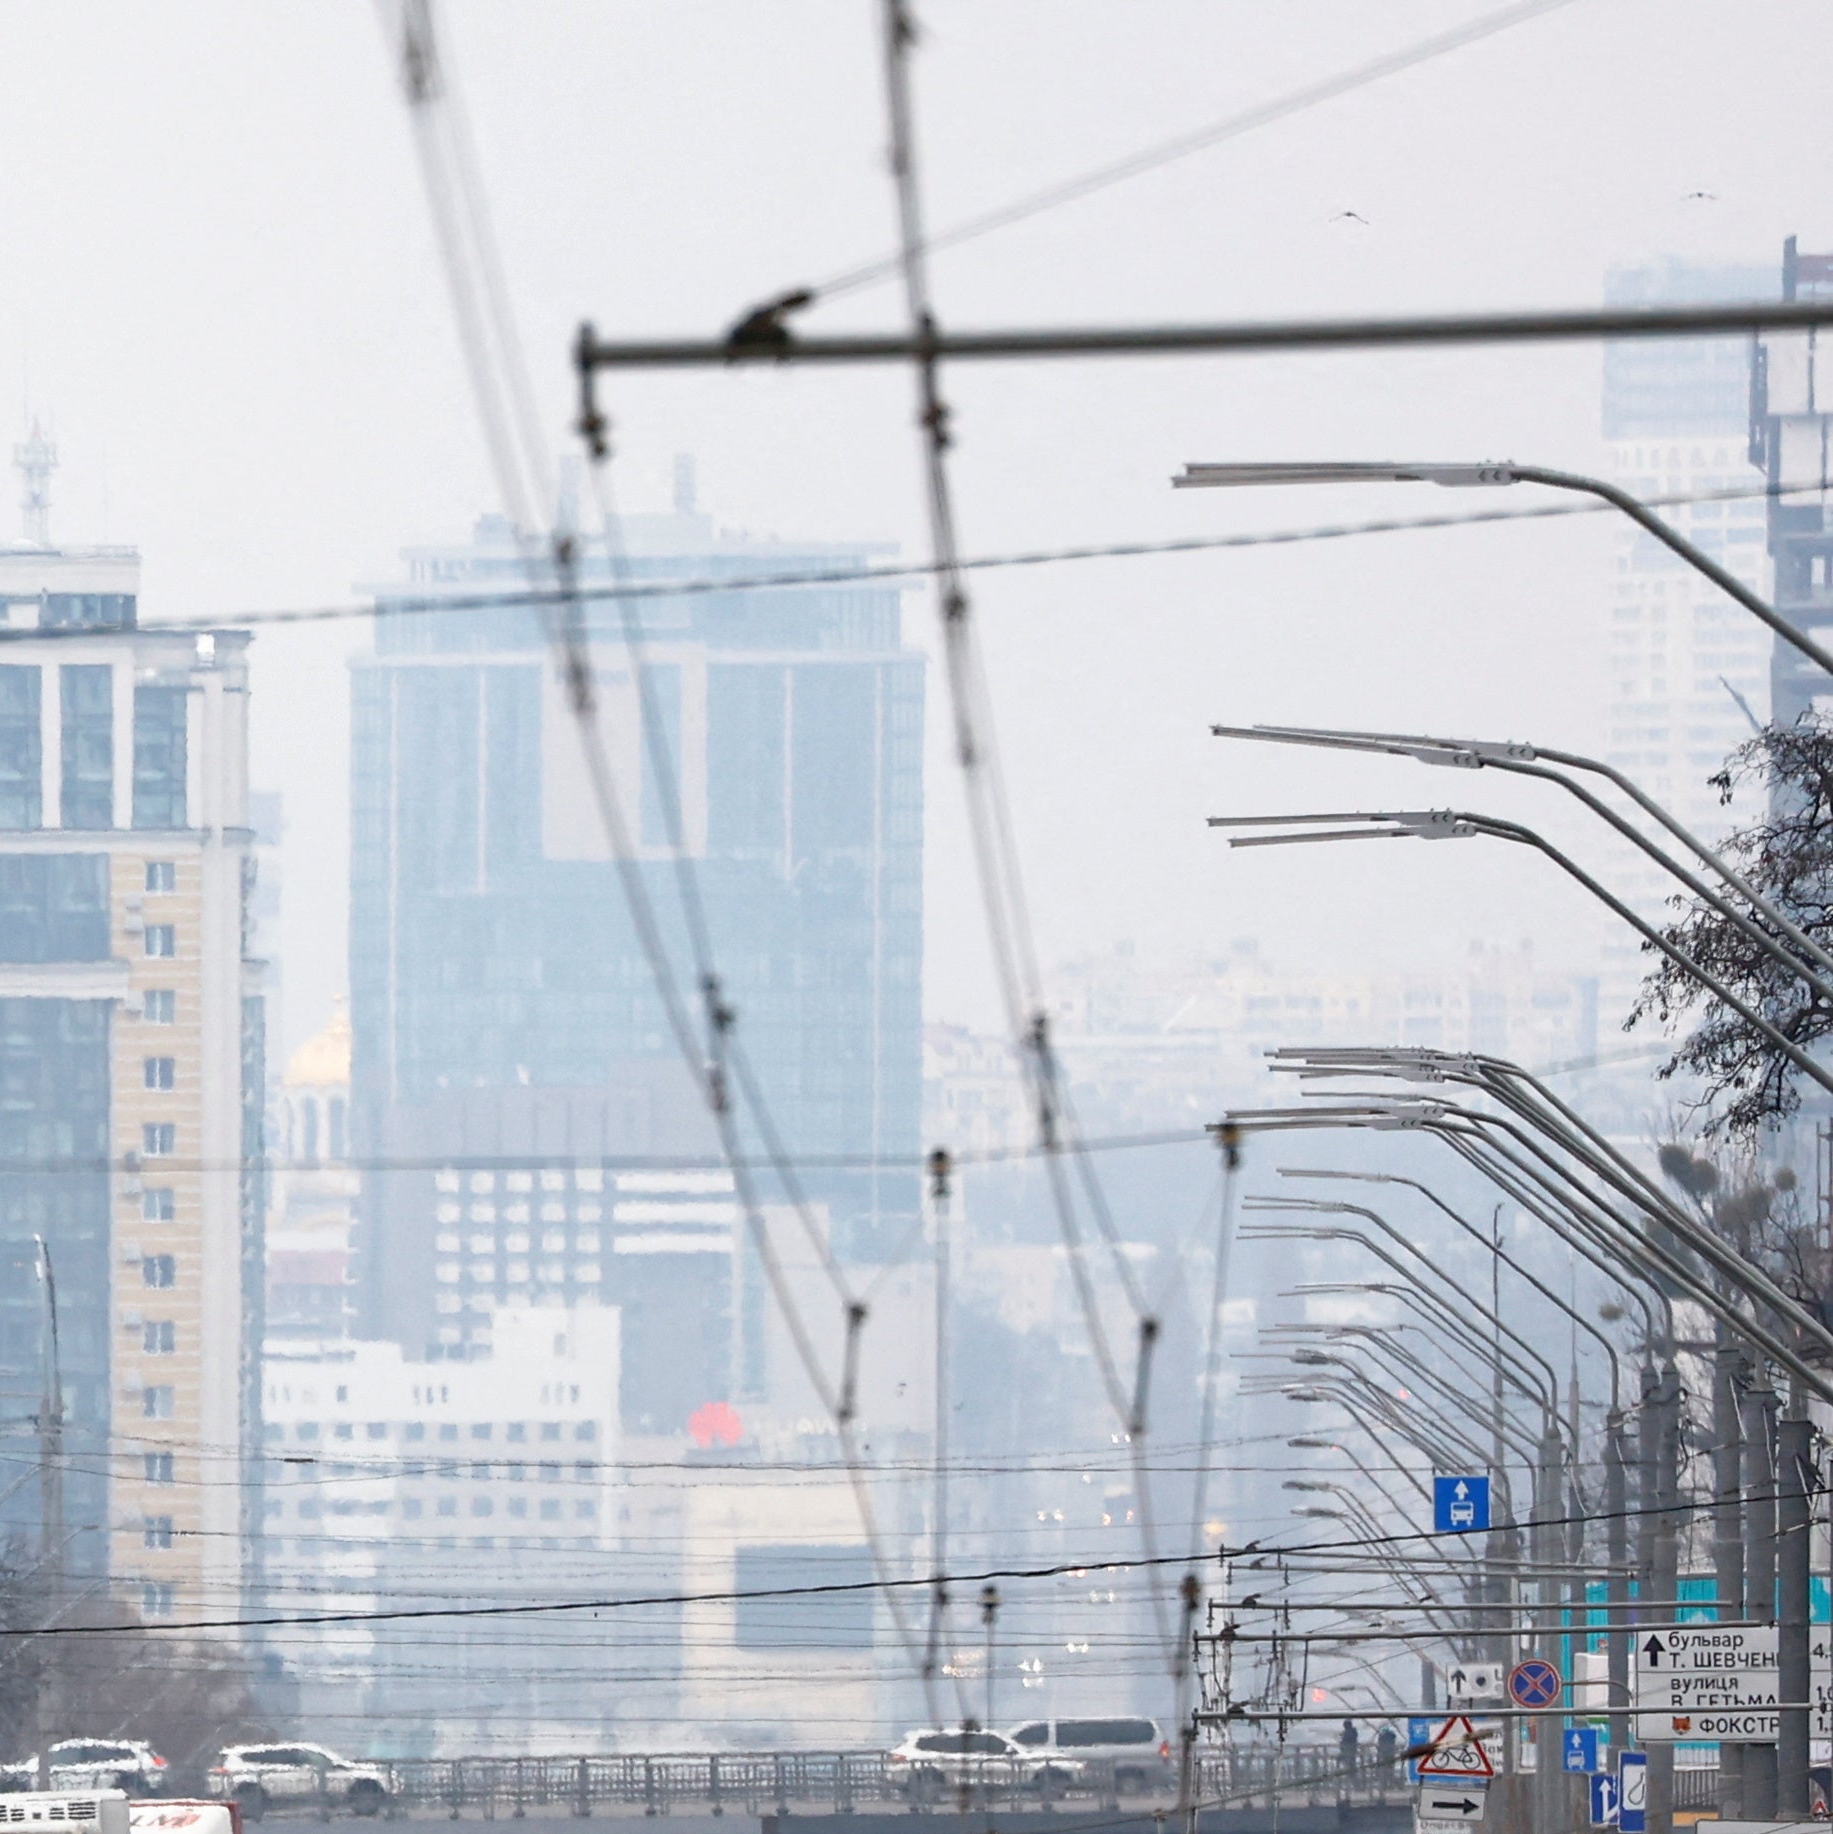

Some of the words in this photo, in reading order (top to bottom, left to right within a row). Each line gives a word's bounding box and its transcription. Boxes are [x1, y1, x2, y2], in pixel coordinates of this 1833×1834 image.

[1668, 1631, 1744, 1651] бульвар
[1669, 1652, 1686, 1669] Т.
[1694, 1651, 1779, 1668] ШЕВЧЕН
[1671, 1678, 1739, 1694] вулиця
